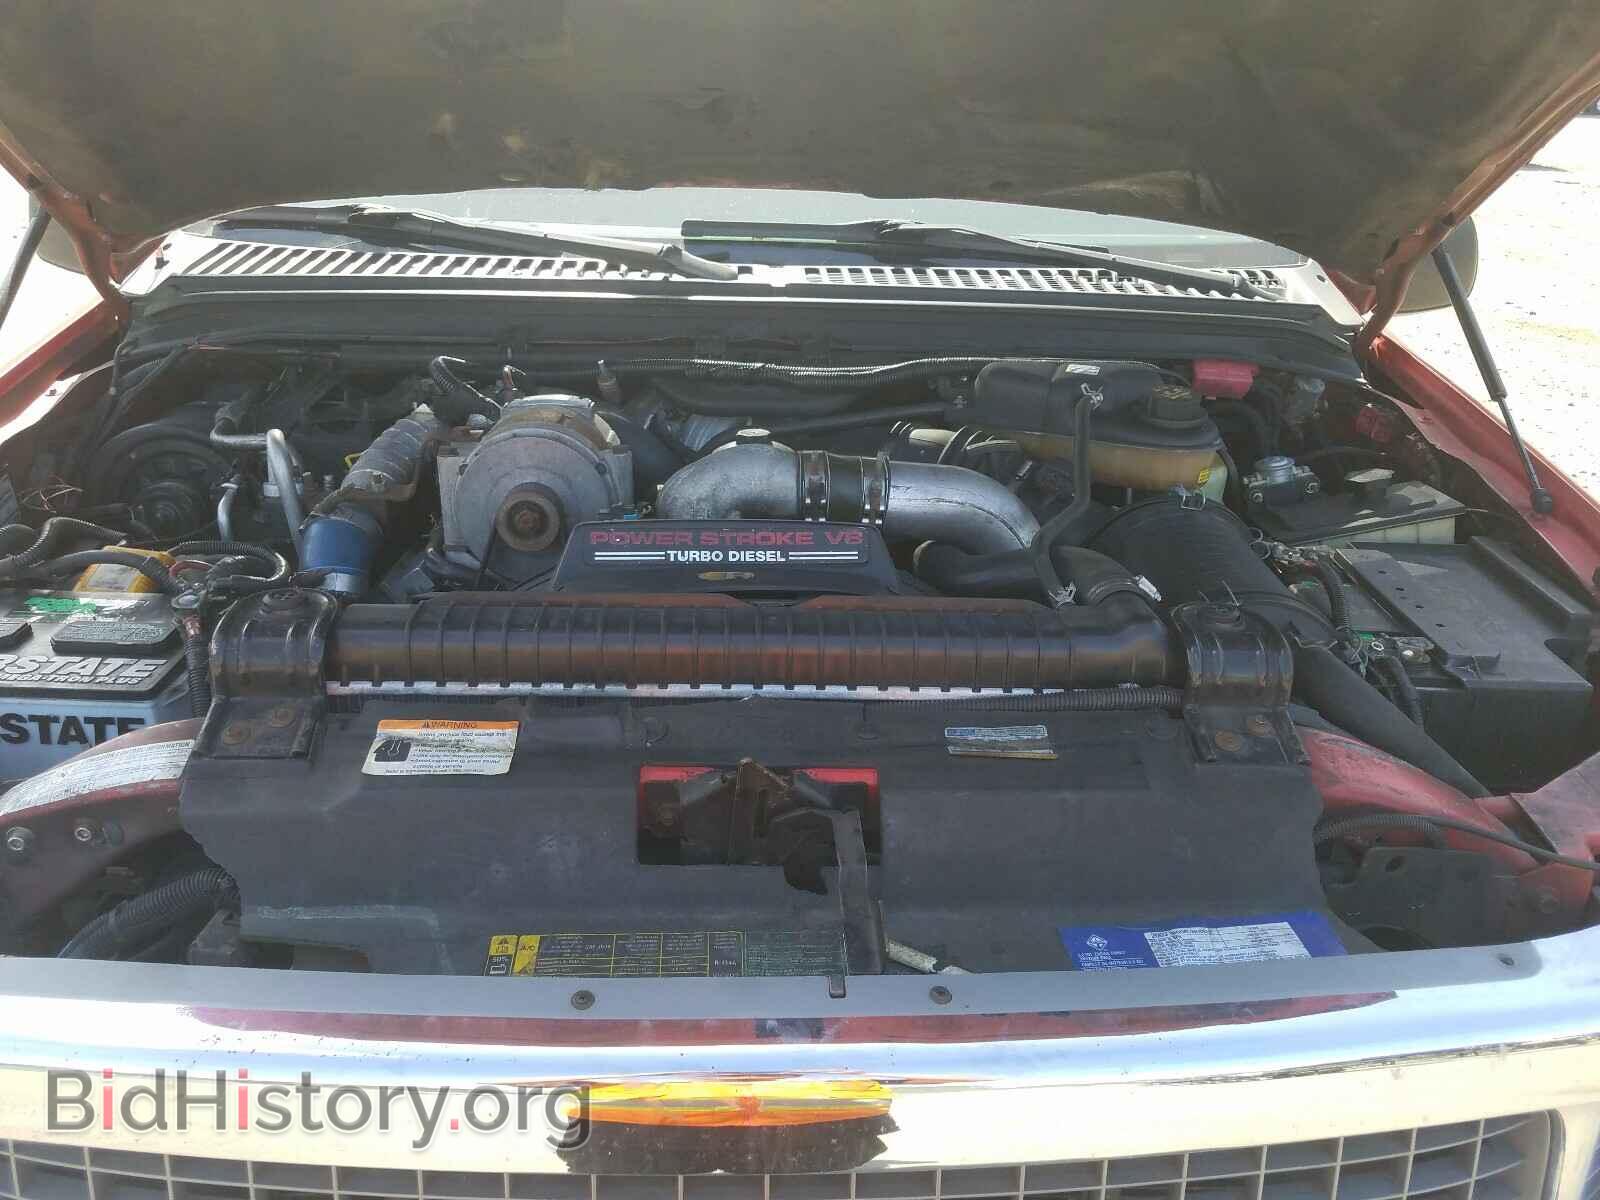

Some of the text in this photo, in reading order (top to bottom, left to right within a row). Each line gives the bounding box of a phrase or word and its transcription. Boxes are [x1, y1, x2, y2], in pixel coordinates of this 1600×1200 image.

[590, 531, 695, 545] POWER
[699, 531, 815, 545] STROKE
[667, 550, 786, 562] TURBO DIESEL
[431, 721, 478, 729] WARNING
